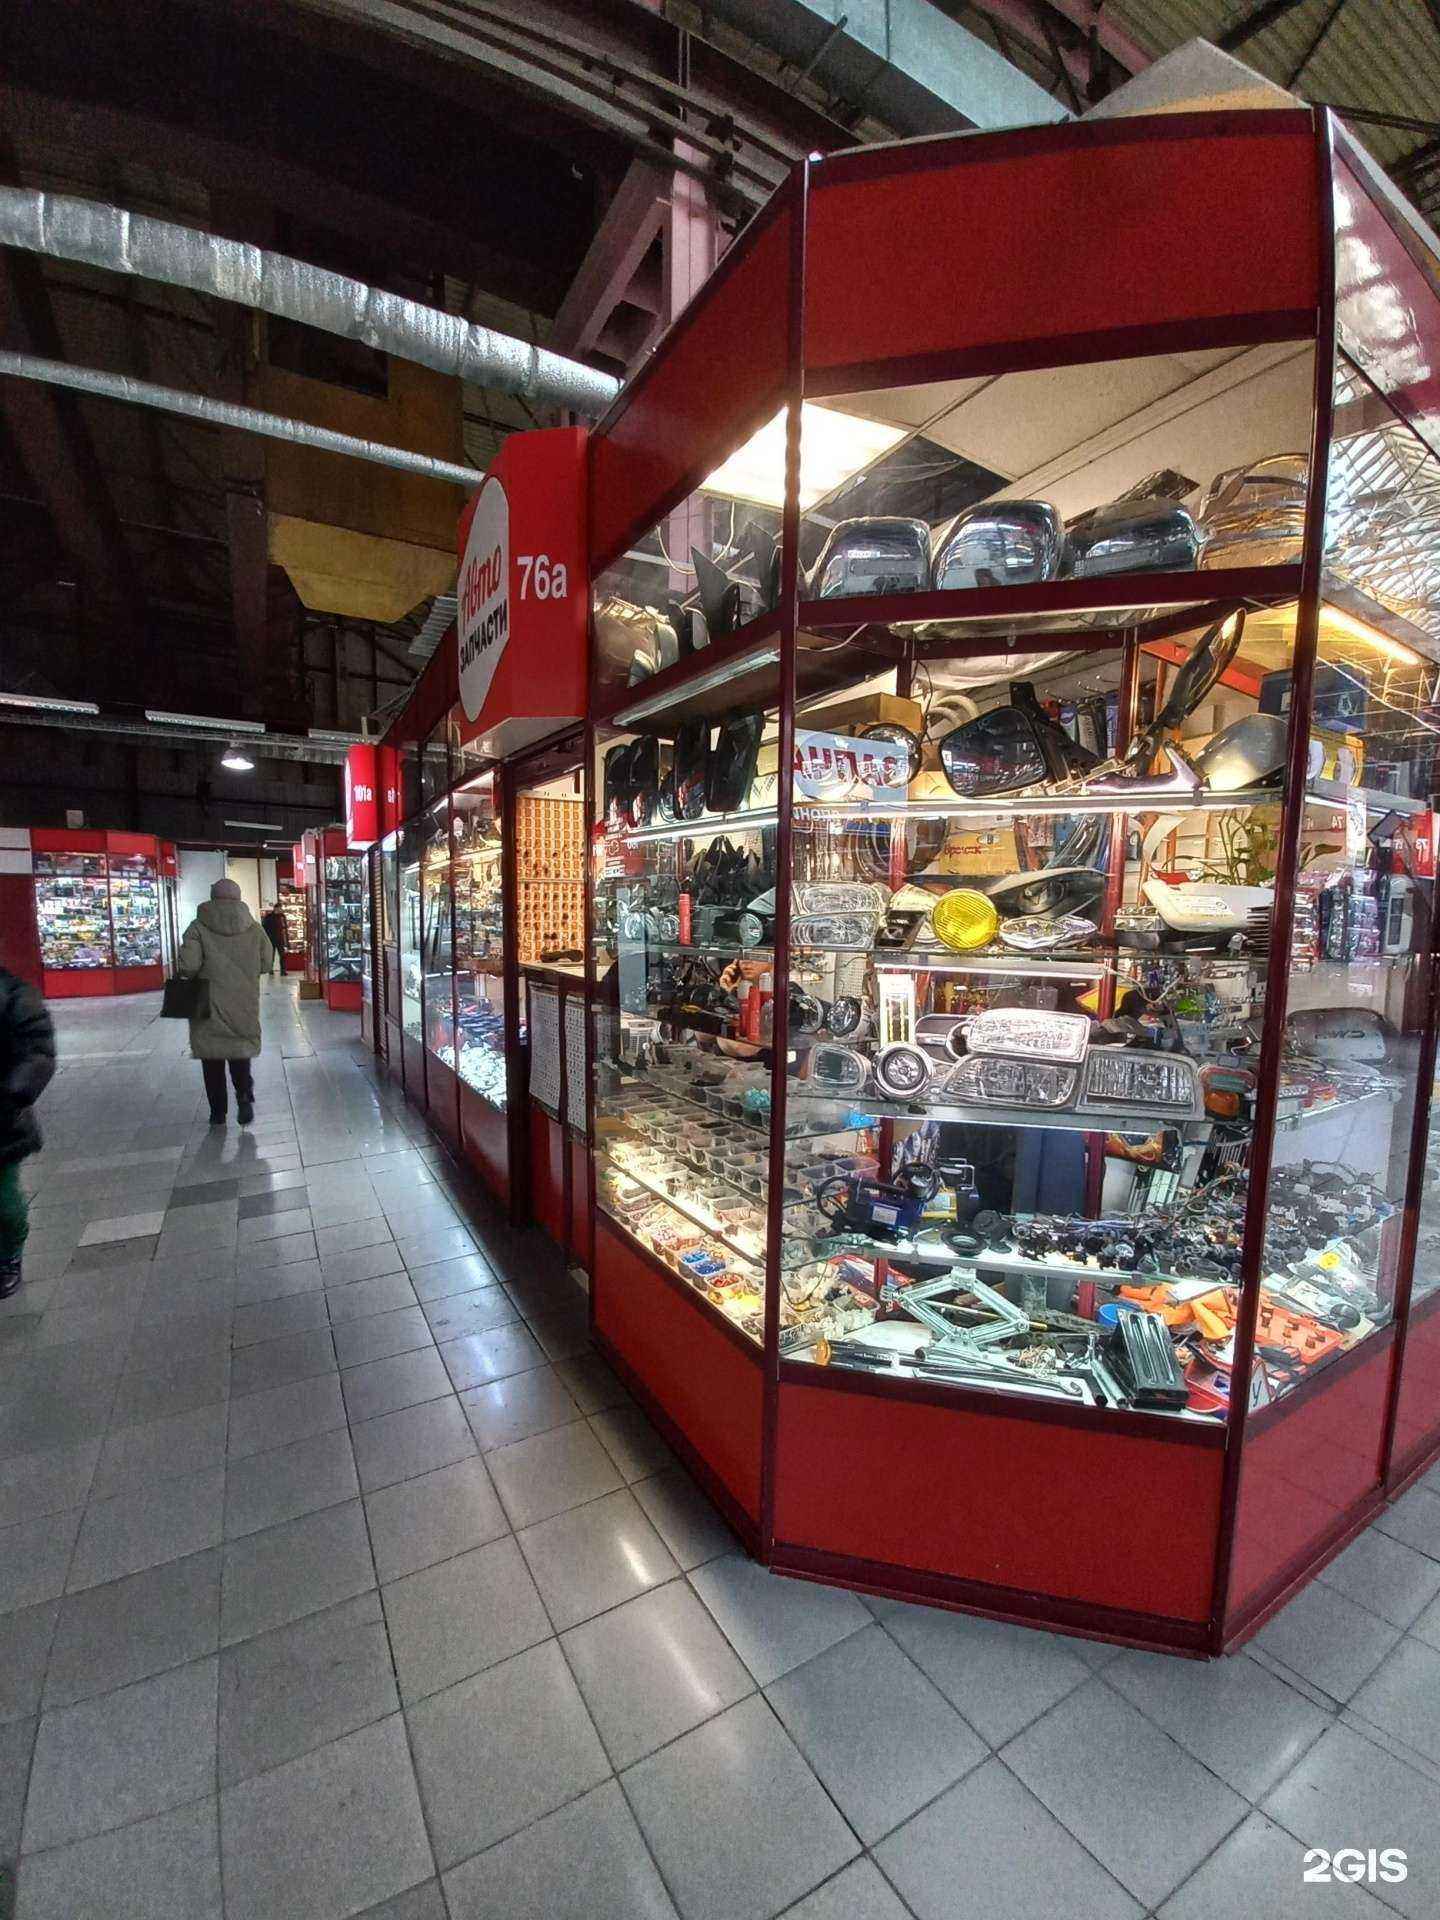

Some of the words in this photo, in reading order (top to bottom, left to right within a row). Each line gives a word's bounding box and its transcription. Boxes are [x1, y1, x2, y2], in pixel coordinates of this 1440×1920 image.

[461, 544, 502, 635] Авто
[516, 554, 568, 601] 76а
[460, 599, 508, 674] ЗАПЧАСТИ
